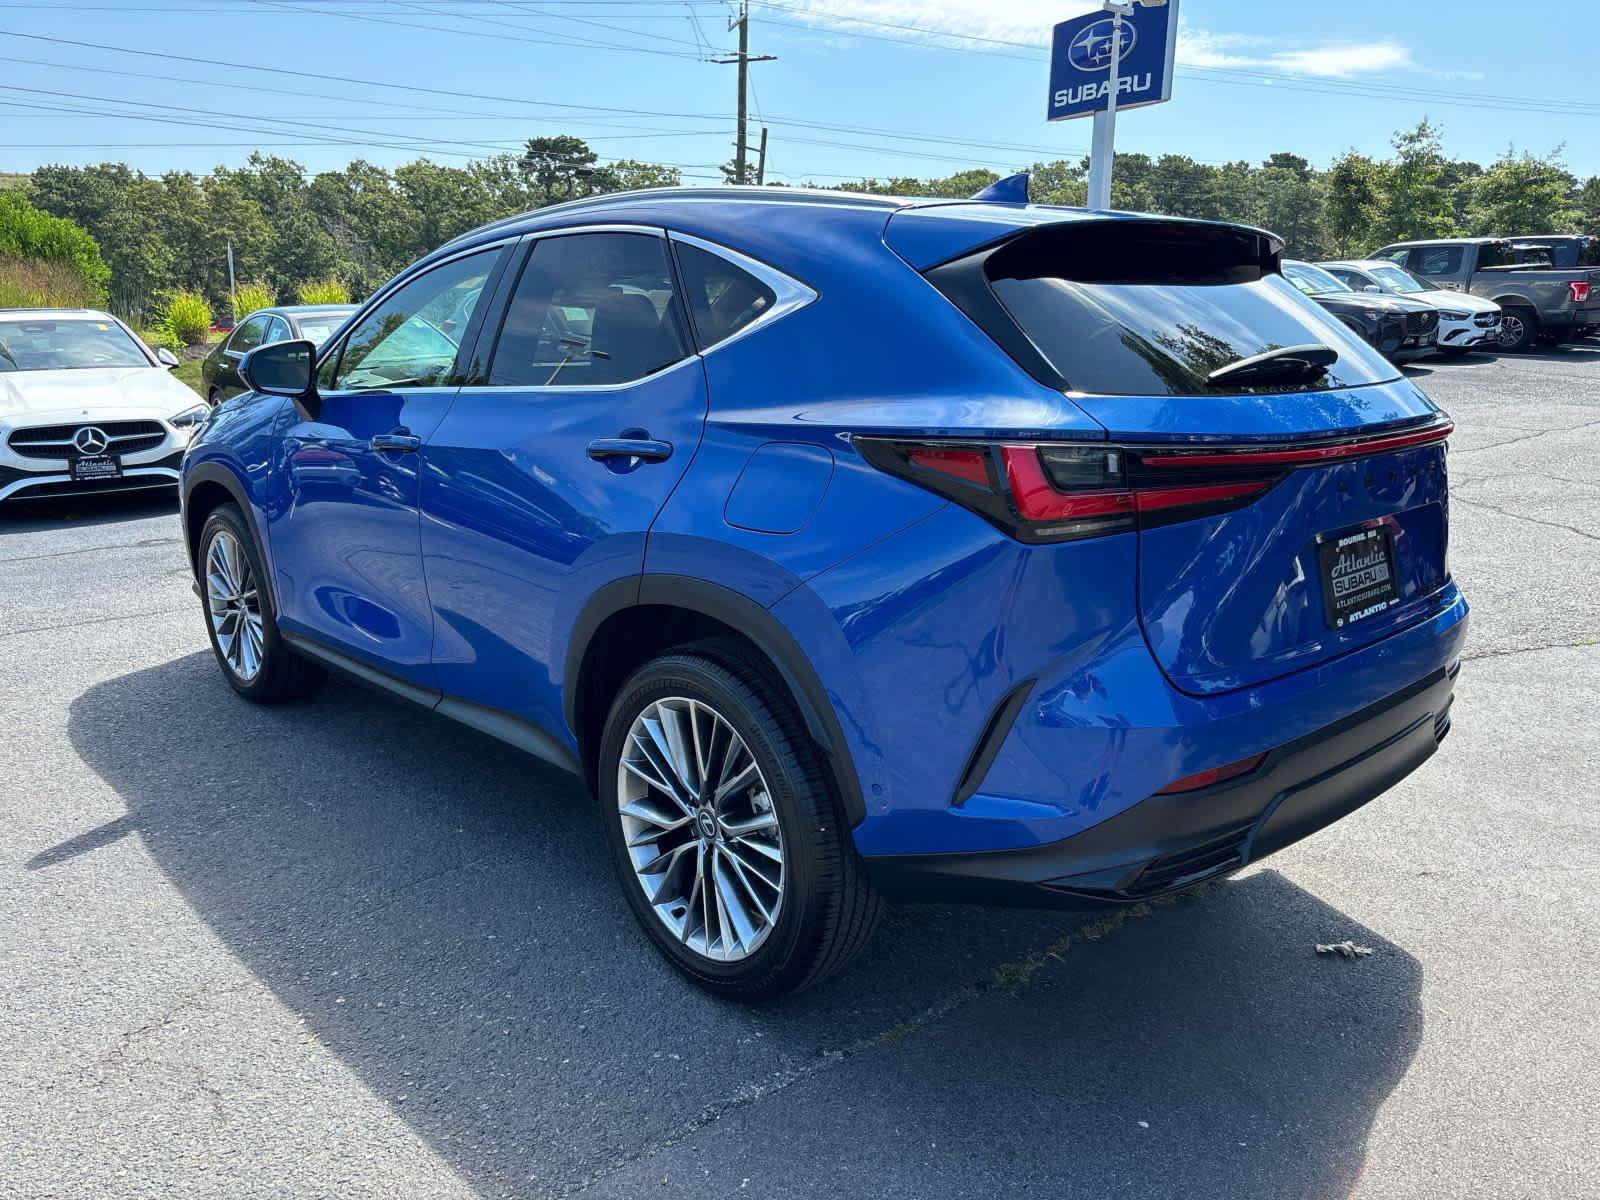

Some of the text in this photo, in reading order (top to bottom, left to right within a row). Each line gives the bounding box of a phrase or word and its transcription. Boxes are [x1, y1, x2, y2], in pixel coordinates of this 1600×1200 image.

[1054, 72, 1152, 108] SUBARU
[1331, 545, 1386, 578] Atlantic
[1334, 567, 1377, 594] SUBARU
[1349, 602, 1387, 622] ATLANTIC
